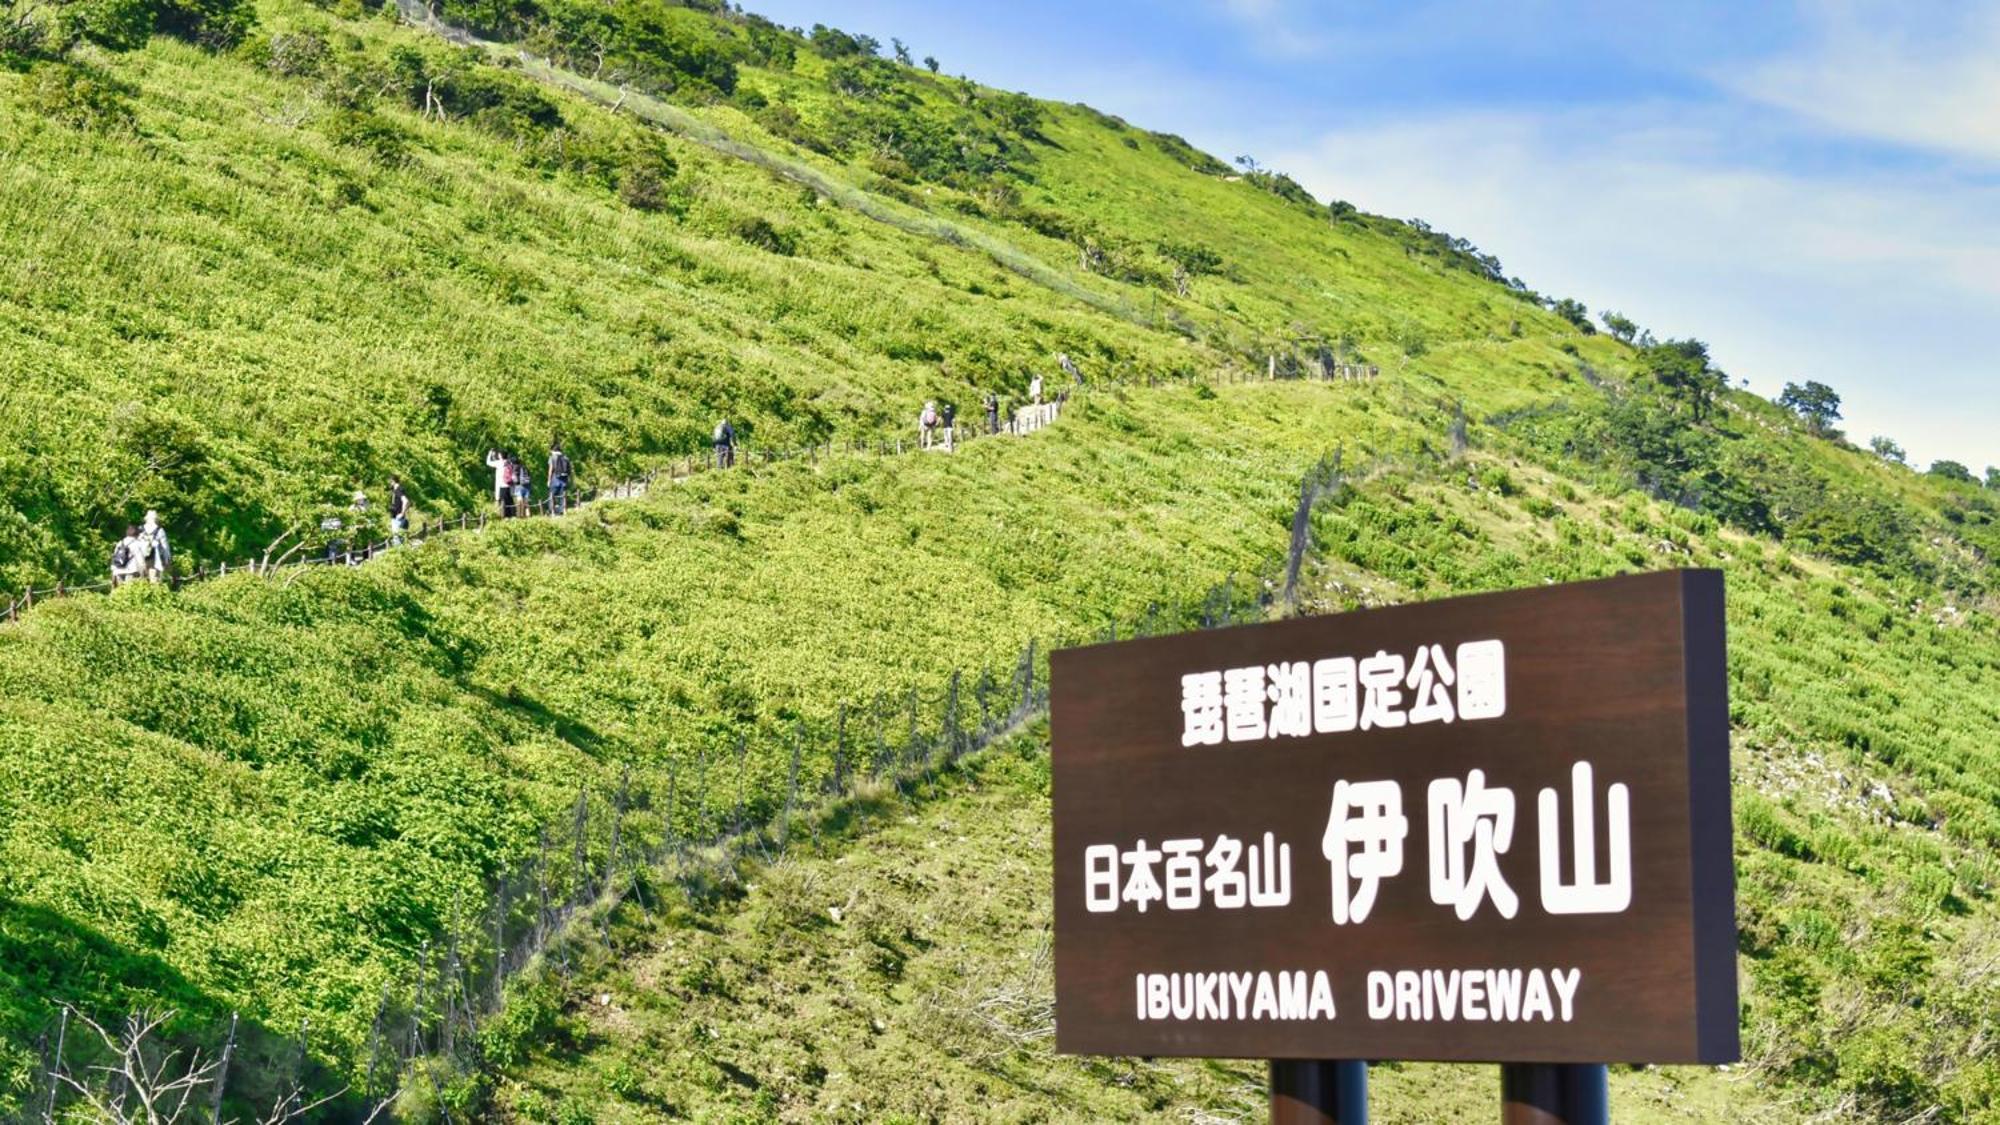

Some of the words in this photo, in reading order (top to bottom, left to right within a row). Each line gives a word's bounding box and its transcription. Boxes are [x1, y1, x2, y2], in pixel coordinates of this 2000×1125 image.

[1180, 639, 1506, 747] 琵琶湖国定公園
[1084, 831, 1292, 913] 日本百名山
[1321, 760, 1632, 926] 伊吹山
[1136, 970, 1336, 1022] IBUKIYAMA
[1367, 967, 1581, 1022] DRIVEWAY
